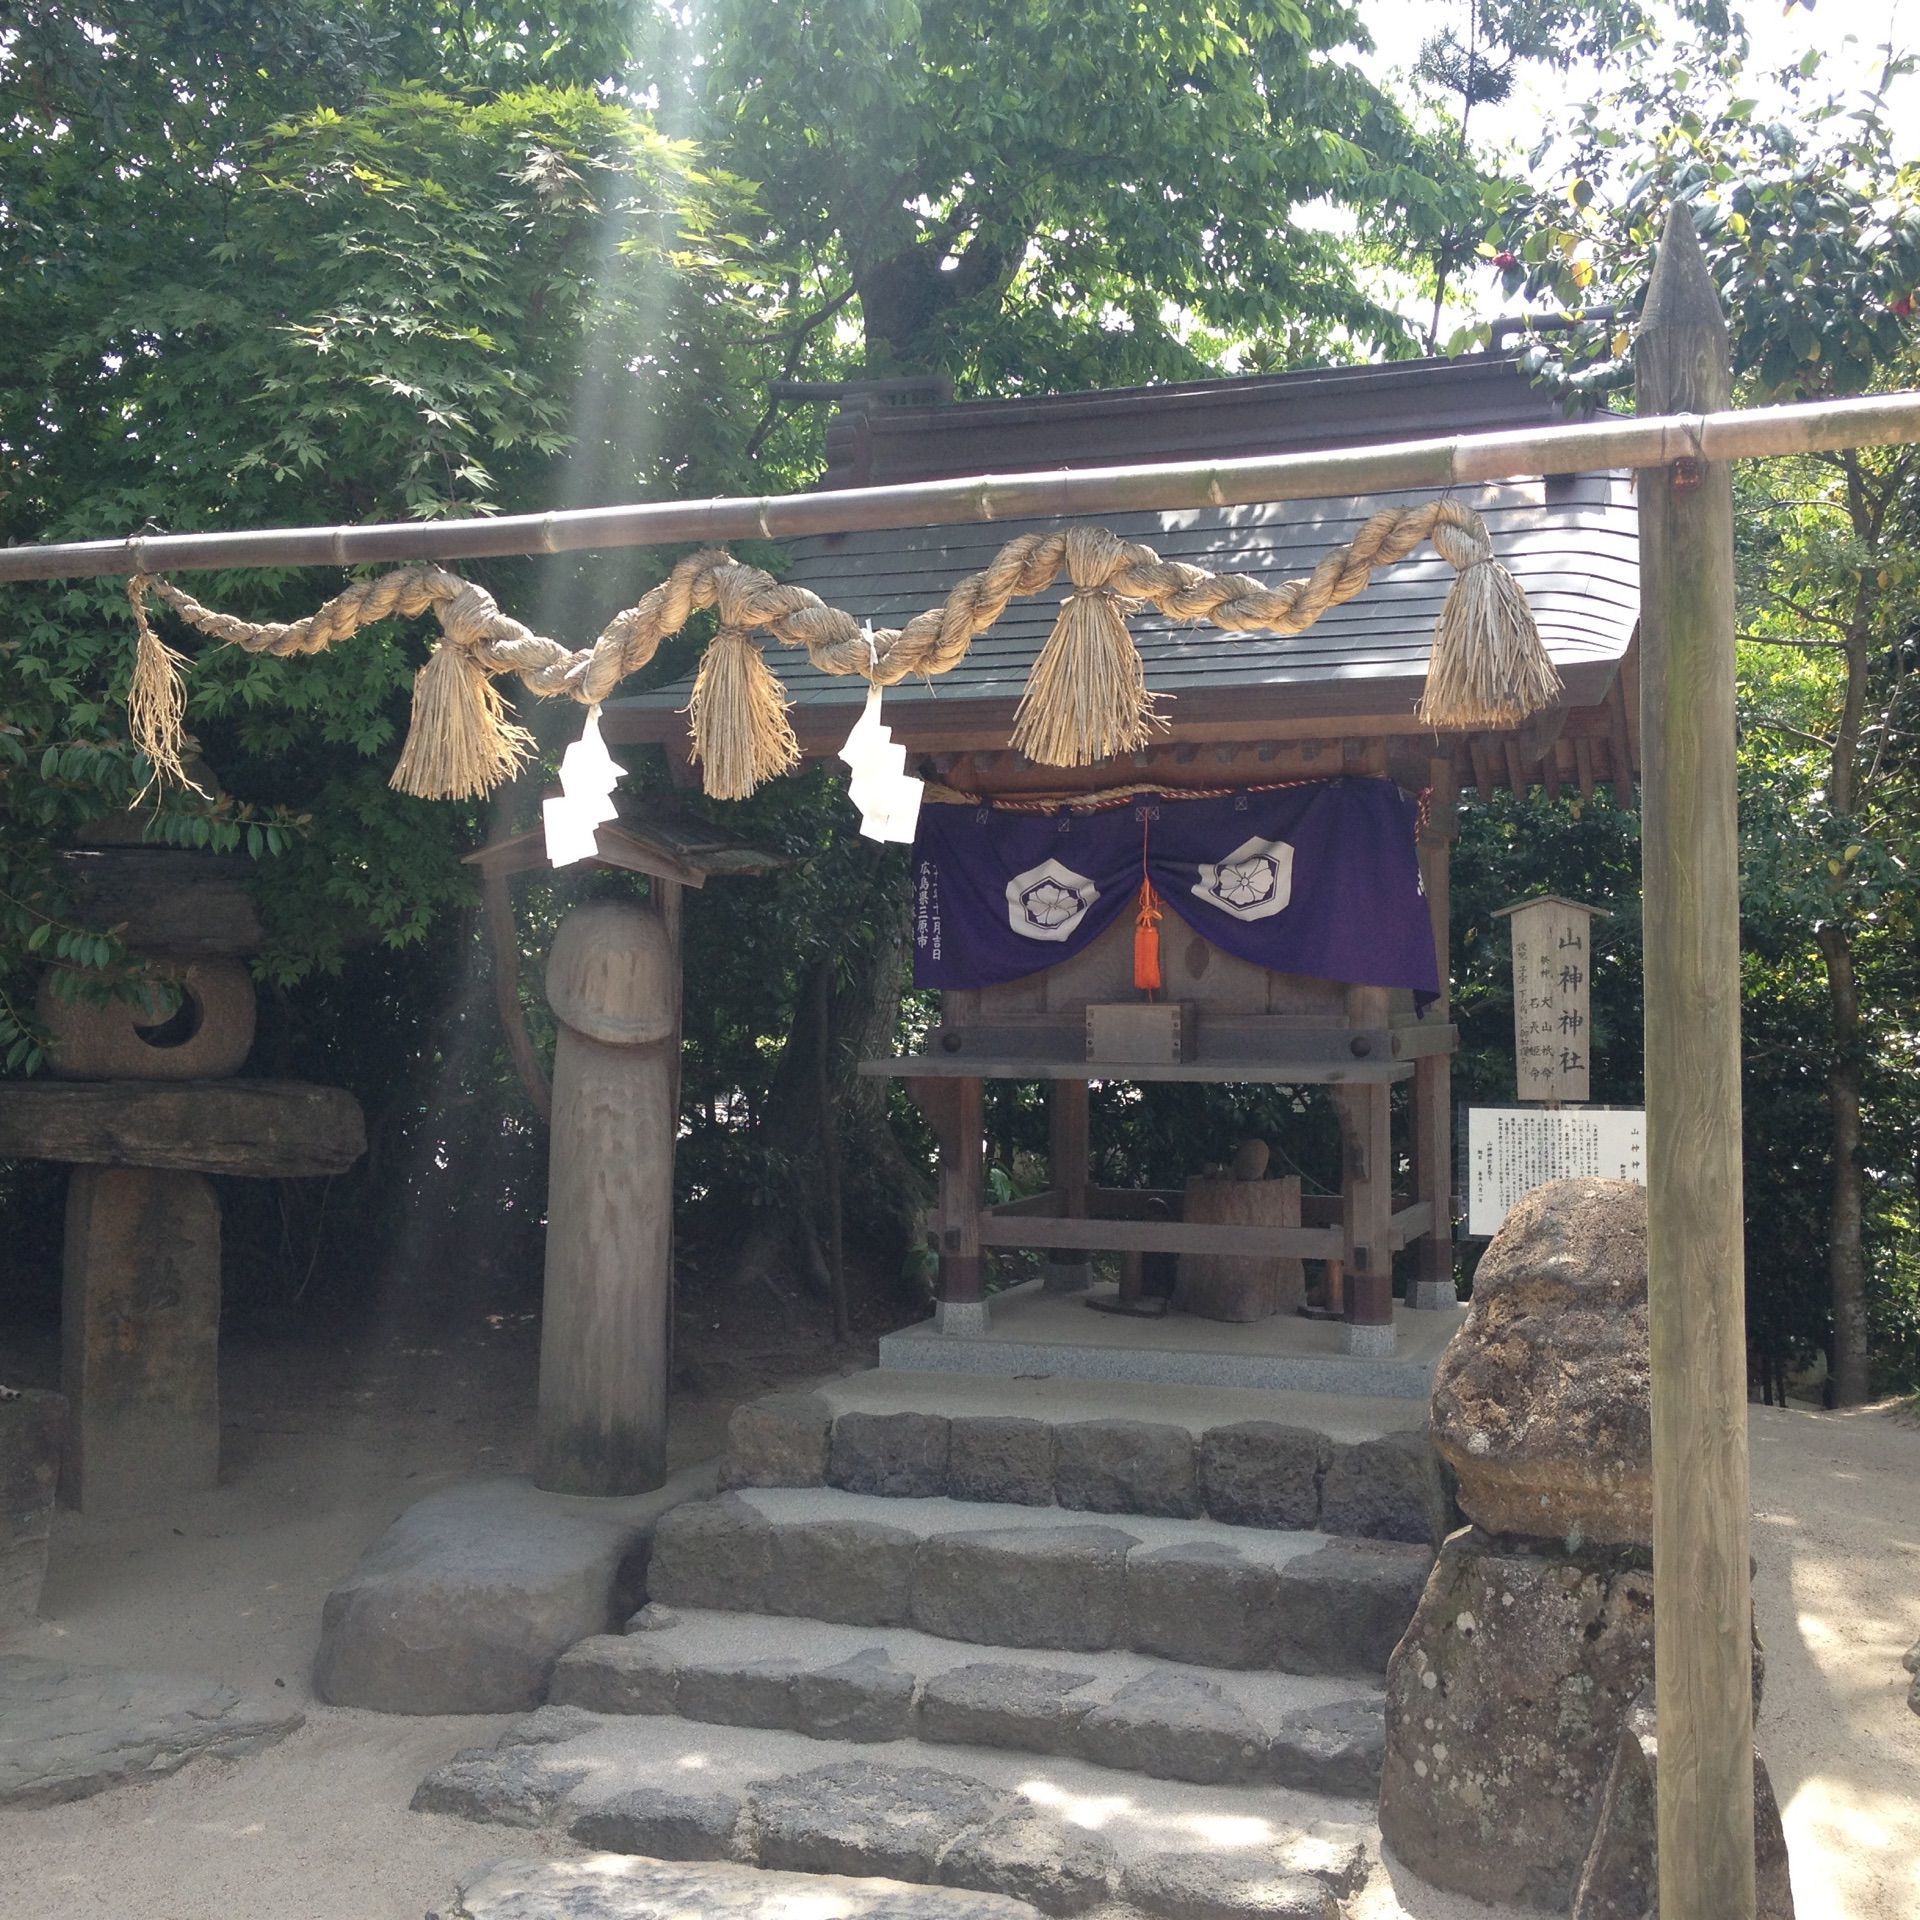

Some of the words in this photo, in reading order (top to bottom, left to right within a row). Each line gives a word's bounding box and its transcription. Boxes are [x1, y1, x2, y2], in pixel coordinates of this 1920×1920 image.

[917, 860, 930, 949] 広島県三原市
[1558, 927, 1584, 1073] 山神神社
